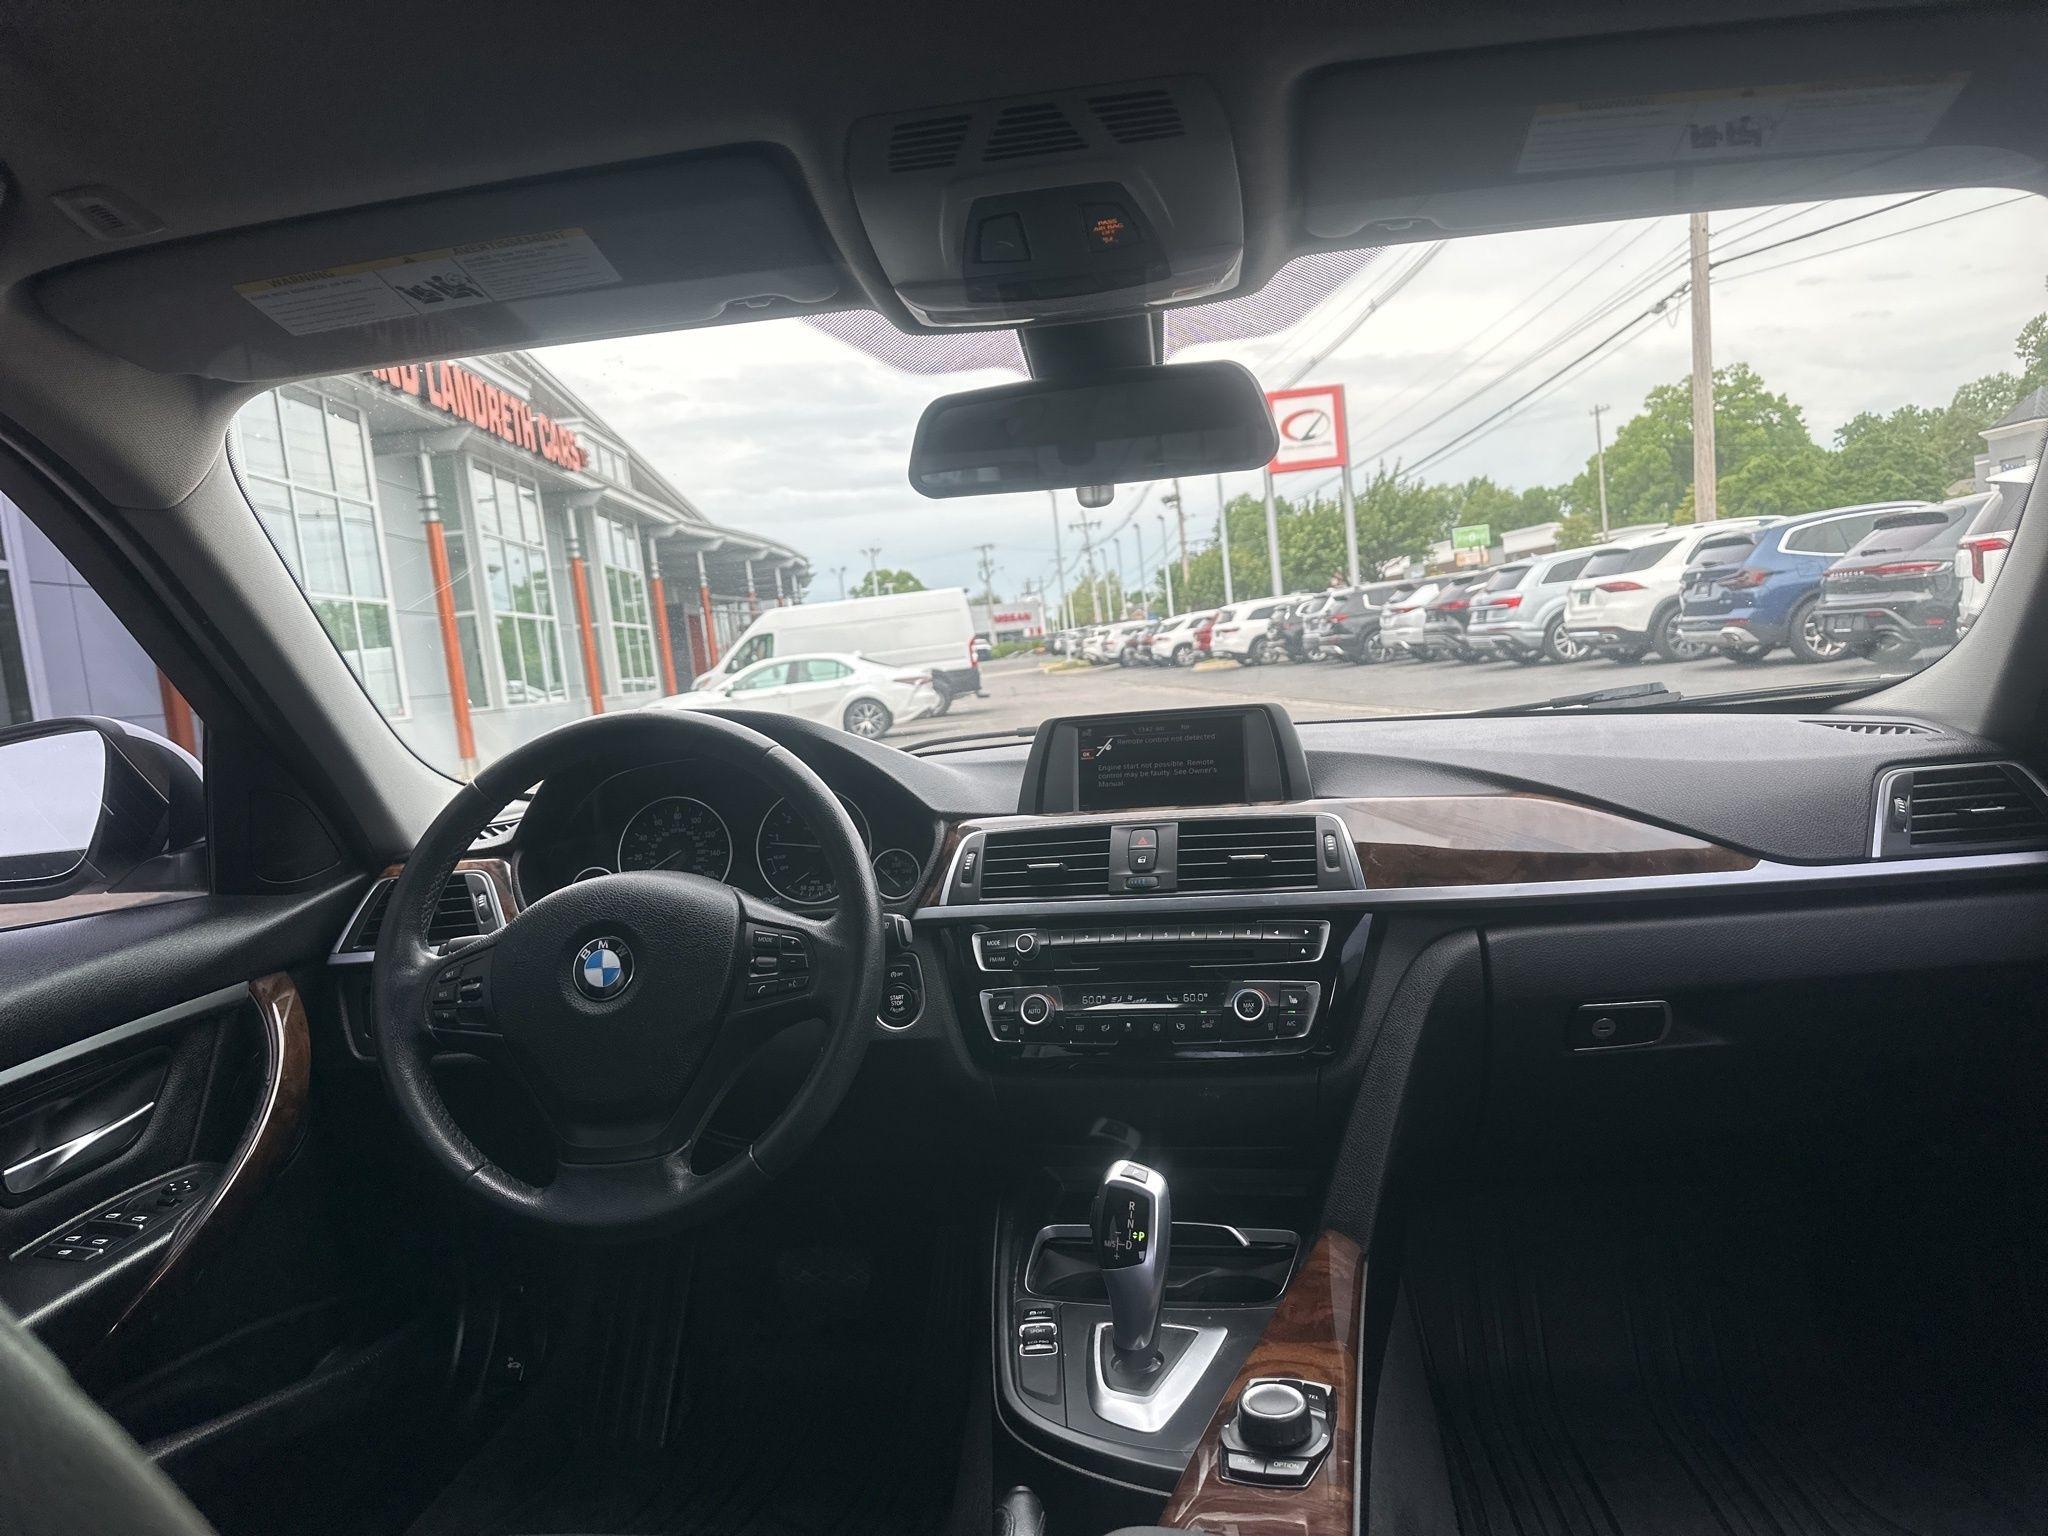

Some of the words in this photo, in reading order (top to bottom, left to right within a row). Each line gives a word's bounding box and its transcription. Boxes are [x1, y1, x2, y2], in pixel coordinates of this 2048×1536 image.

[266, 269, 336, 289] WARNING
[425, 361, 537, 454] LANDRETH
[538, 411, 586, 473] CARS
[1184, 734, 1216, 742] detected
[580, 940, 628, 960] BMW
[1273, 1461, 1300, 1469] OPTION
